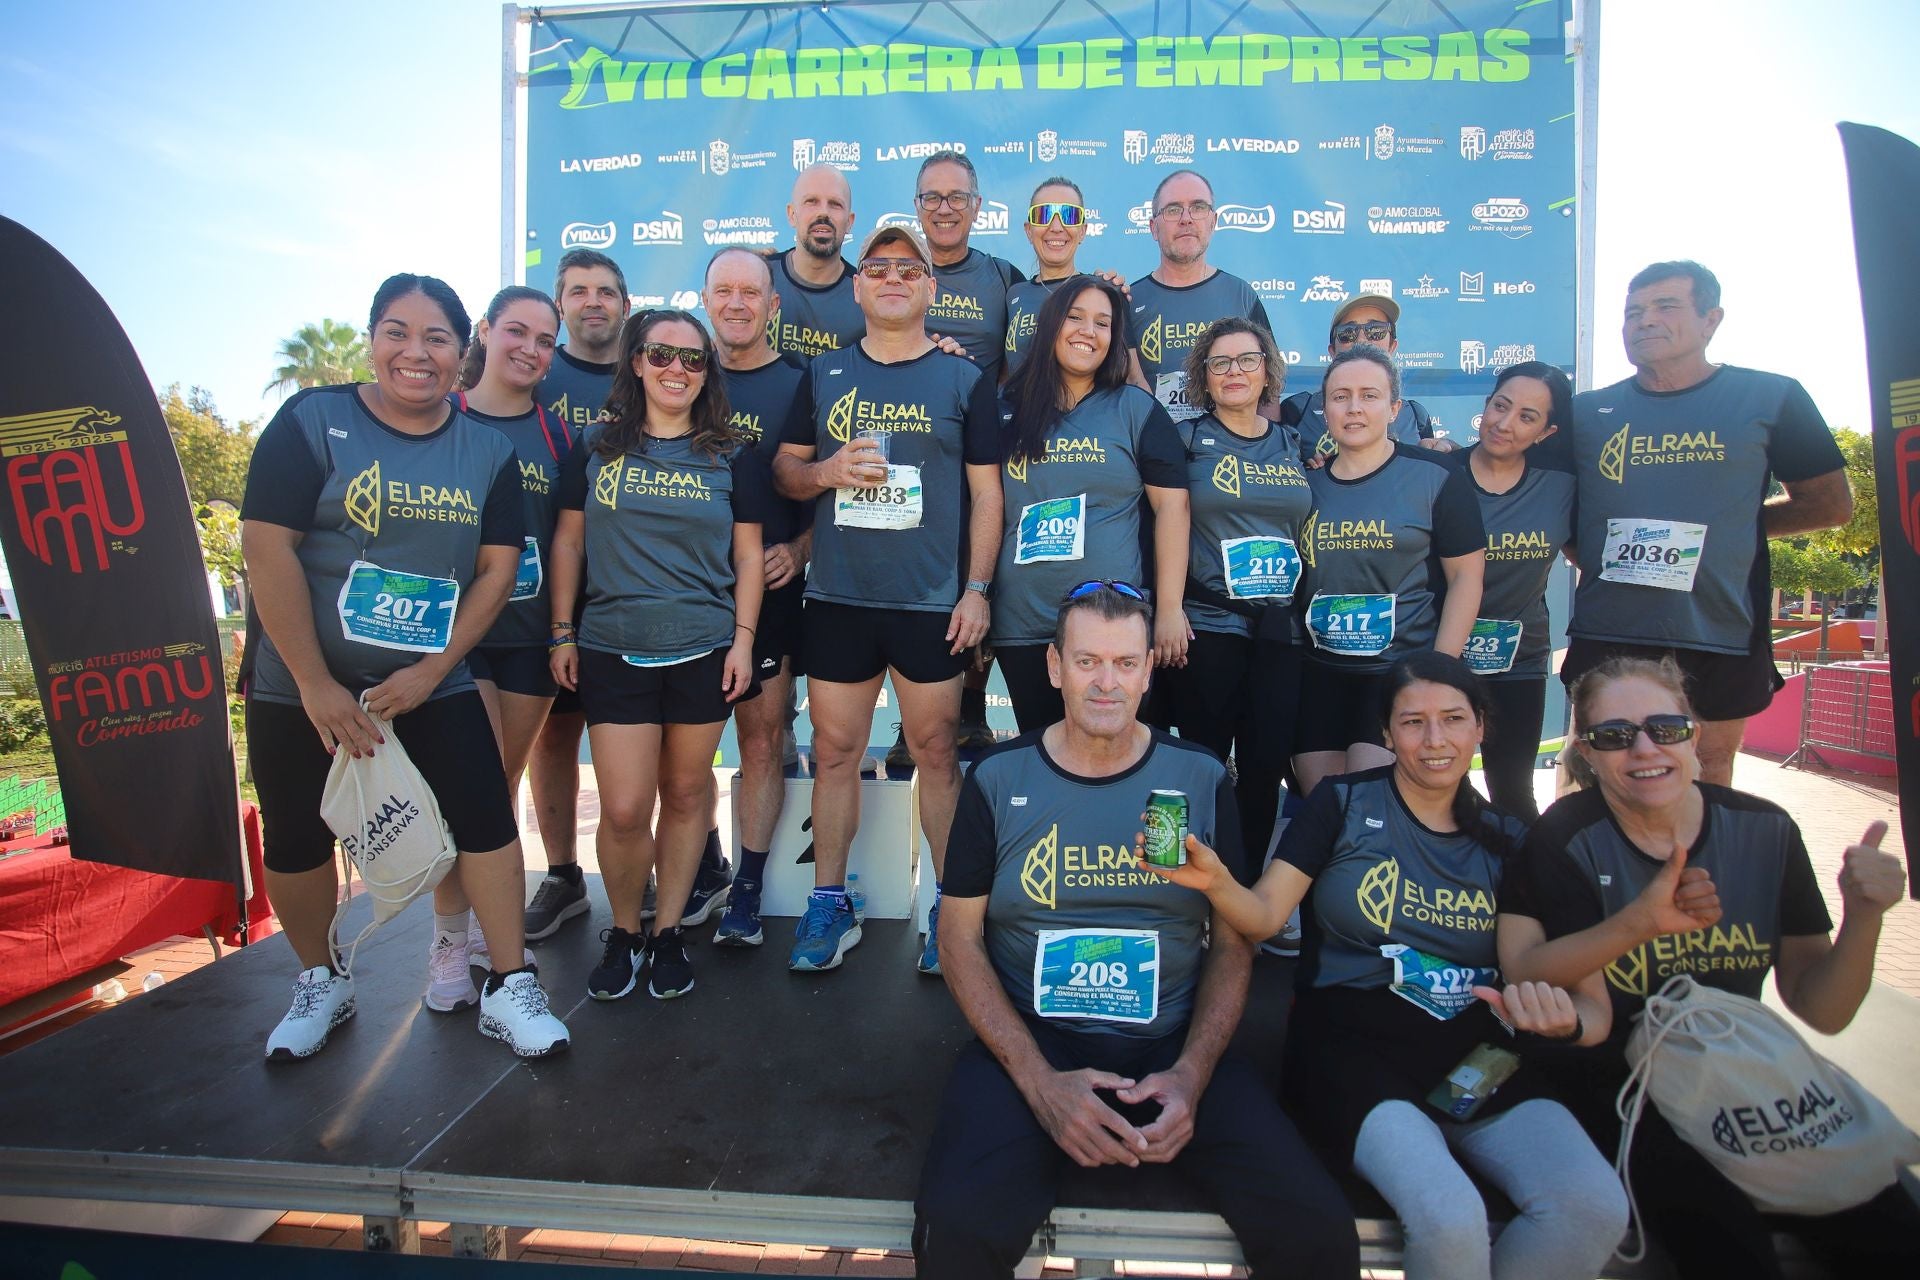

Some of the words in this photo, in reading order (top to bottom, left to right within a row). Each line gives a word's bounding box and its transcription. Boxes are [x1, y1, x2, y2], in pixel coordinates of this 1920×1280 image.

[701, 44, 1024, 101] CARRERA
[1037, 38, 1124, 90] DE
[1136, 29, 1530, 89] EMPRESAS
[1059, 138, 1107, 149] Ayuntamiento
[1207, 138, 1231, 152] LA
[1231, 138, 1300, 154] VERDAD
[1397, 136, 1444, 146] Ayuntamiento
[1488, 142, 1535, 151] ATLETISMO
[1494, 133, 1534, 143] murcia
[731, 150, 777, 162] Ayuntamiento
[816, 153, 861, 162] ATLETISMO
[876, 148, 900, 162] LA
[899, 142, 966, 159] VERDAD
[1069, 147, 1097, 156] Murcia
[1150, 145, 1195, 155] ATLETISMO
[1407, 145, 1433, 154] Murcia
[560, 158, 581, 173] LA
[580, 153, 642, 172] VERDAD
[731, 162, 741, 170] de
[741, 159, 766, 169] Murcia
[974, 210, 1009, 230] SM
[1222, 212, 1267, 225] VIDAL
[1293, 210, 1345, 229] DSM
[569, 229, 609, 243] VIDAL
[633, 220, 683, 241] DSM
[1402, 286, 1450, 296] ESTRELLA
[1493, 280, 1536, 295] Hero
[931, 294, 983, 311] LRAAL
[928, 308, 985, 321] ONSERVAS
[1395, 351, 1444, 360] Ayuntamiento
[1493, 348, 1535, 358] murcia
[1405, 359, 1433, 367] Murcia
[855, 419, 932, 433] CONSERVAS
[15, 441, 57, 455] 1925
[70, 433, 114, 447] 2025
[1045, 436, 1106, 453] LRAAL
[1630, 450, 1725, 466] CONSERVAS
[624, 483, 711, 501] CONSERVAS
[852, 485, 907, 505] 2033
[387, 505, 479, 526] CONSERVAS
[1036, 516, 1078, 537] 209
[1317, 539, 1394, 551] CONSERVAS
[1487, 531, 1551, 551] LRAAL
[1485, 550, 1550, 561] ONSERVAS
[1617, 543, 1681, 565] 2036
[1249, 557, 1287, 576] 212
[371, 592, 431, 622] 207
[1327, 613, 1372, 631] 217
[85, 647, 162, 669] ATLETISMO
[50, 655, 214, 721] FAMU
[76, 707, 205, 748] Corriendo
[360, 805, 420, 865] ONSERVAS
[1657, 952, 1771, 978] CONSERVAS
[1068, 961, 1129, 988] 208
[1424, 968, 1475, 994] 222
[1054, 990, 1089, 999] CONSERVAS
[1751, 1105, 1854, 1156] CONSERVAS
